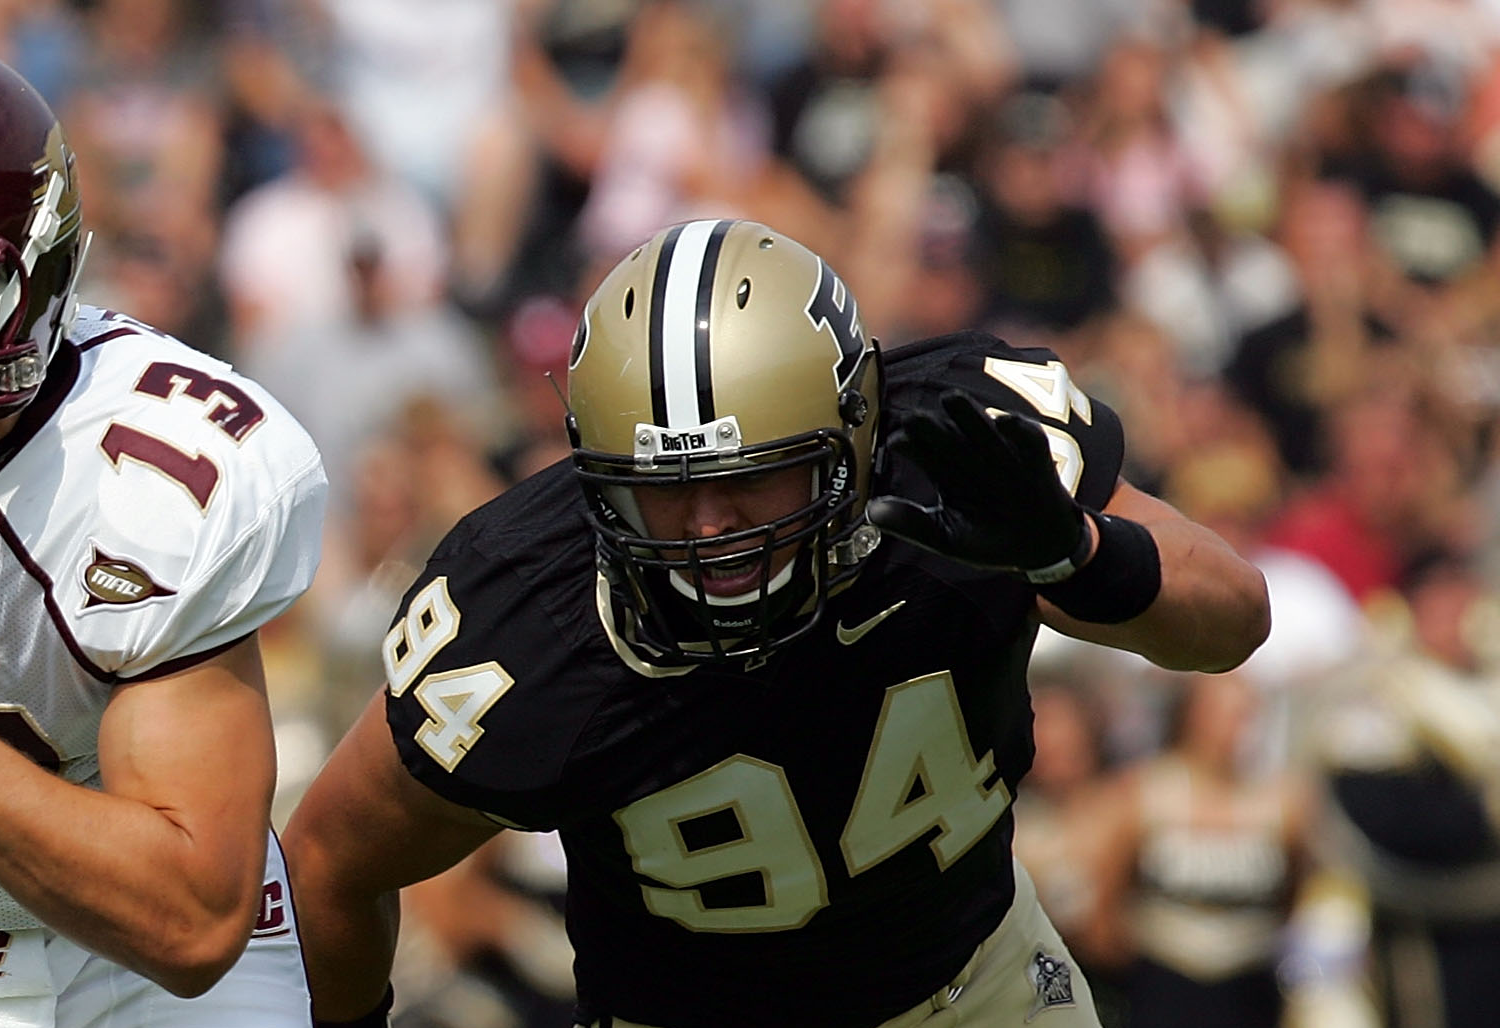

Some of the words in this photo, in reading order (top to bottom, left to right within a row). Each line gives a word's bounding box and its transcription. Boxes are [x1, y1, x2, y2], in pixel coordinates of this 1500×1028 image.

[100, 360, 268, 518] 13
[381, 575, 515, 774] 94
[612, 669, 1012, 934] 94
